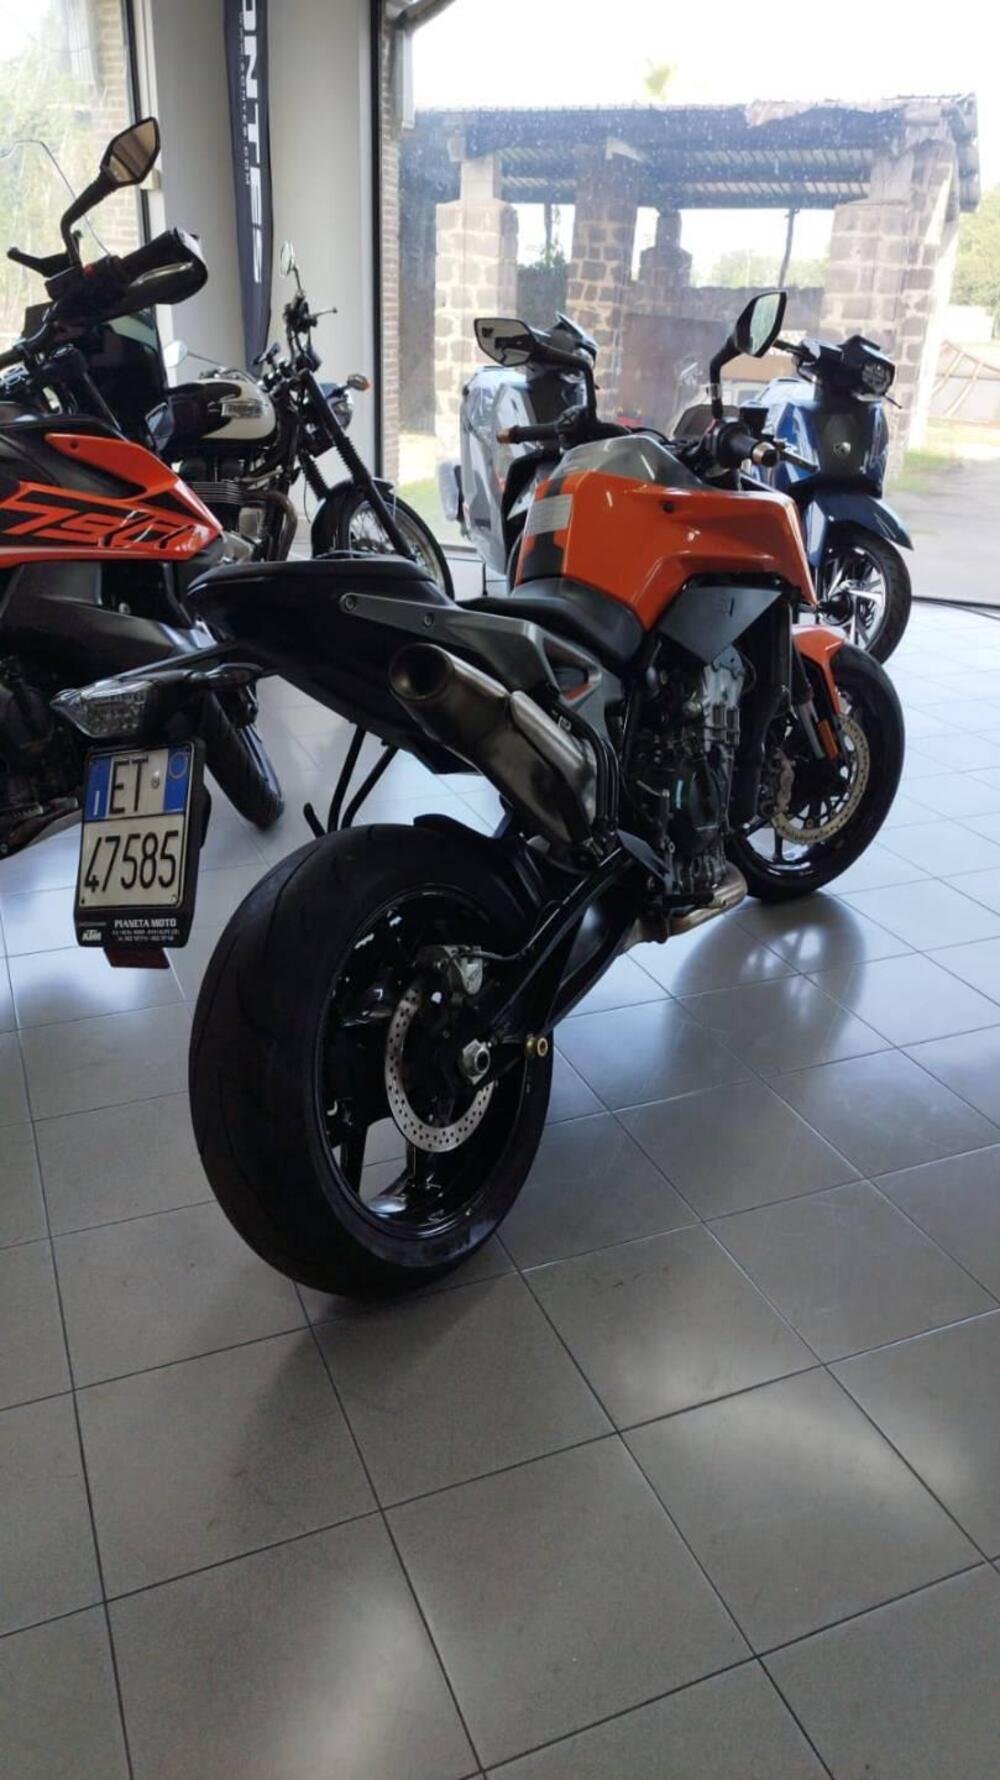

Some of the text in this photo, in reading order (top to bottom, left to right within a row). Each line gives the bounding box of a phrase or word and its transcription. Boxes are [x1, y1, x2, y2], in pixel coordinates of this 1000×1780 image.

[109, 759, 149, 814] ET
[84, 831, 179, 892] 47585
[82, 929, 102, 942] KTM
[114, 918, 177, 928] PIANETA MOTO
